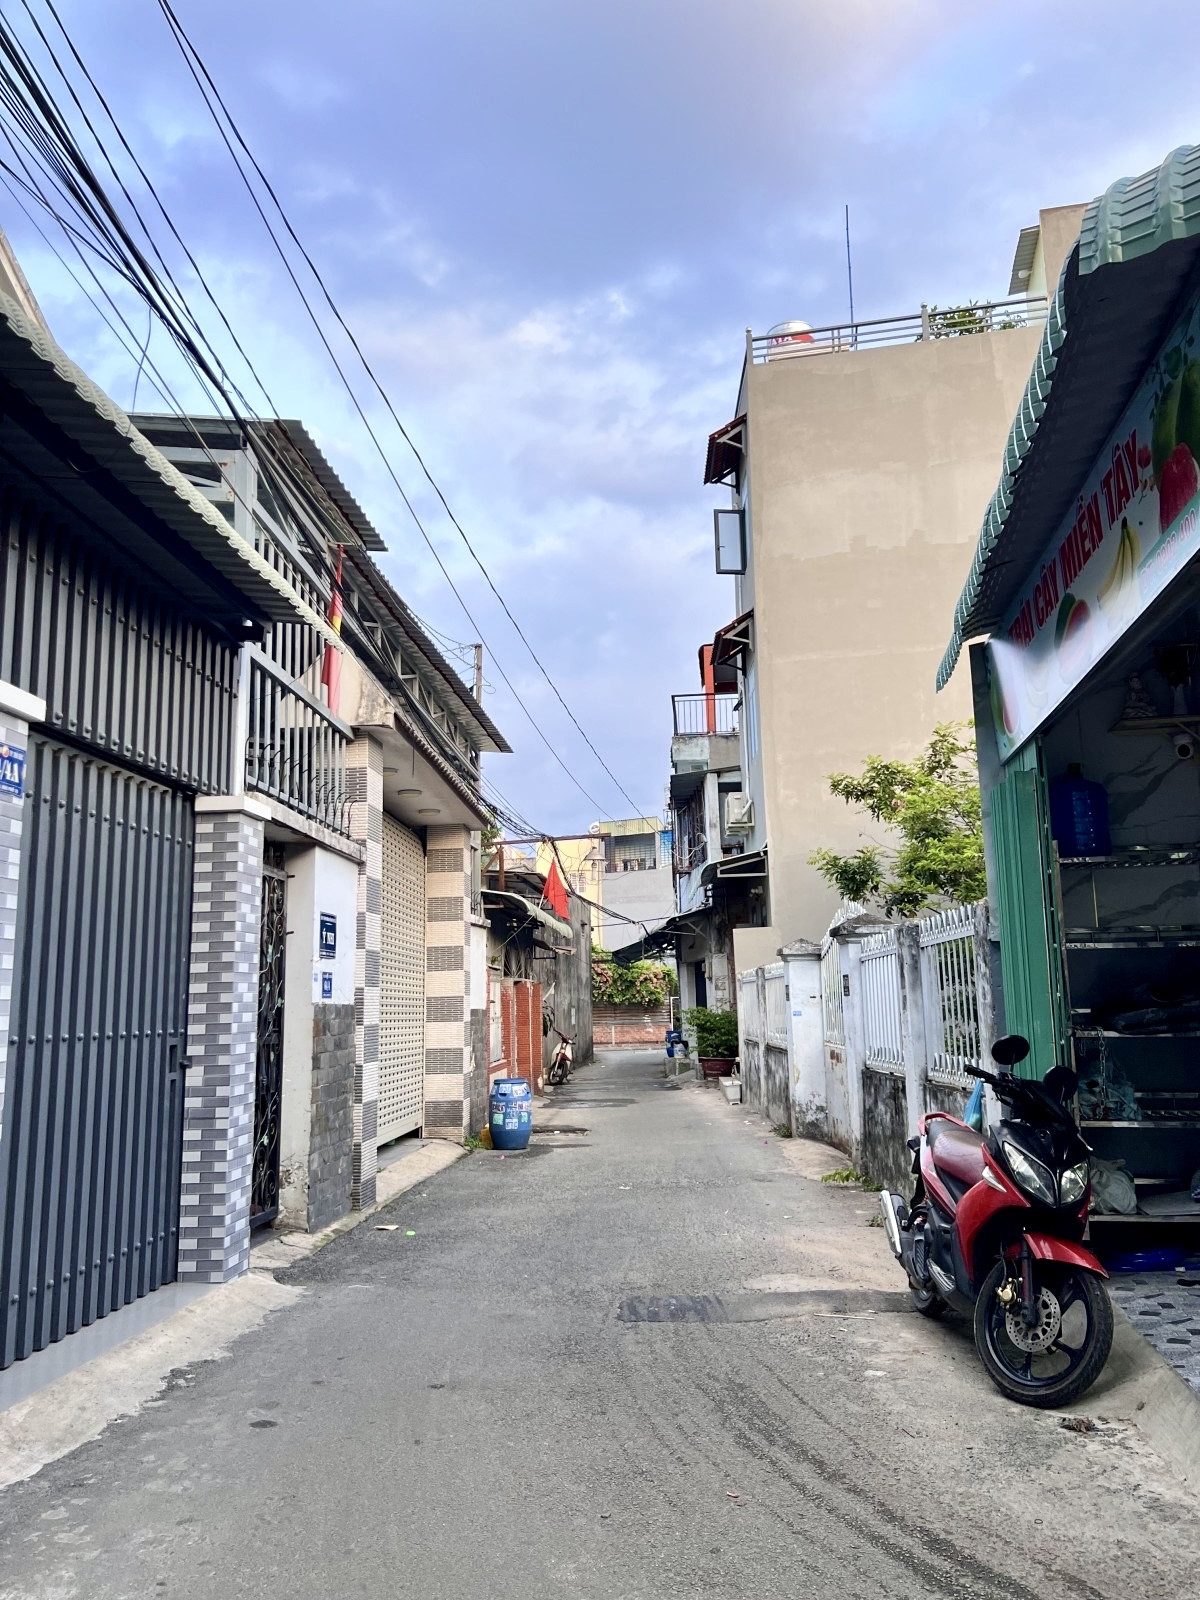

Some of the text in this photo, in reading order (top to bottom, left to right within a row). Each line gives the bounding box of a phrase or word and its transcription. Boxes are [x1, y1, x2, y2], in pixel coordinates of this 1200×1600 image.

[1032, 563, 1059, 631] CÂY
[1058, 495, 1103, 591] MIỀN
[1101, 429, 1140, 530] TÂY
